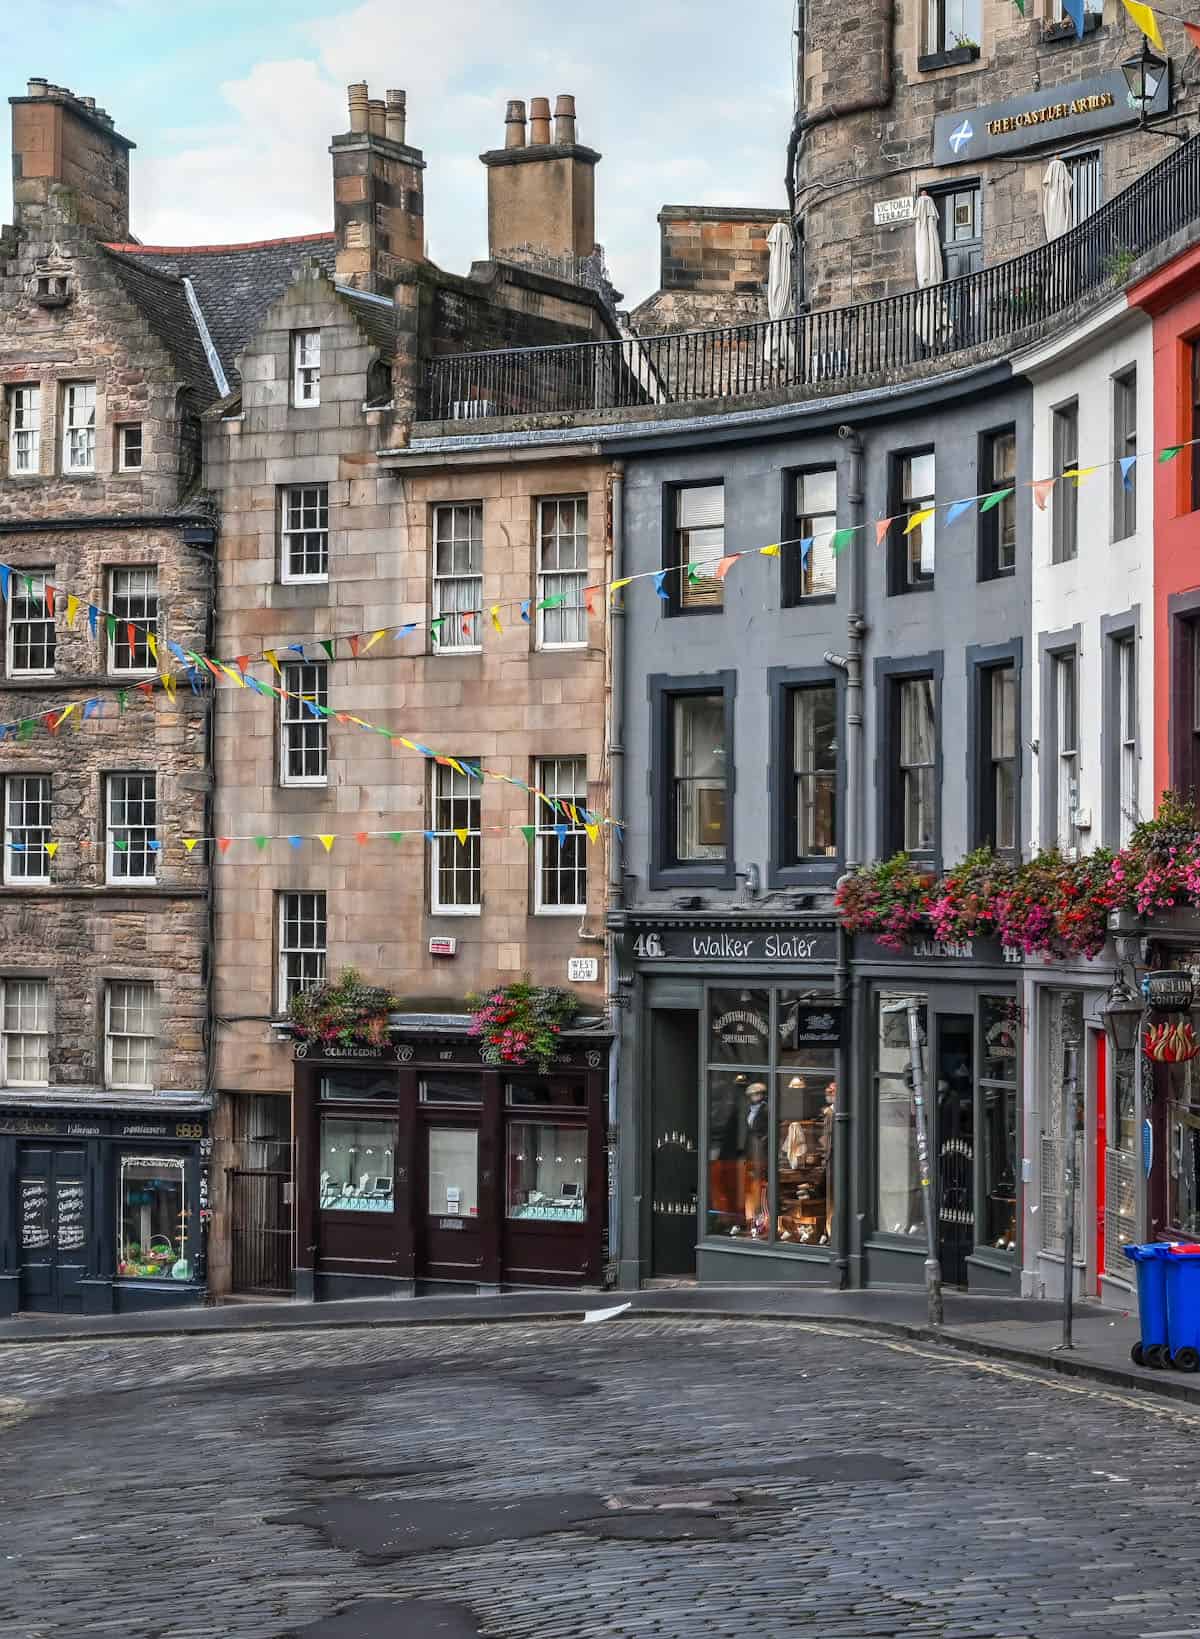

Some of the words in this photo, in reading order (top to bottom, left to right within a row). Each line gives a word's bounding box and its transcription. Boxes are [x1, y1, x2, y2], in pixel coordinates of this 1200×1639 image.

[692, 933, 753, 957] Walker
[764, 933, 817, 957] Slater
[571, 959, 593, 969] WEST
[571, 969, 593, 979] BOW
